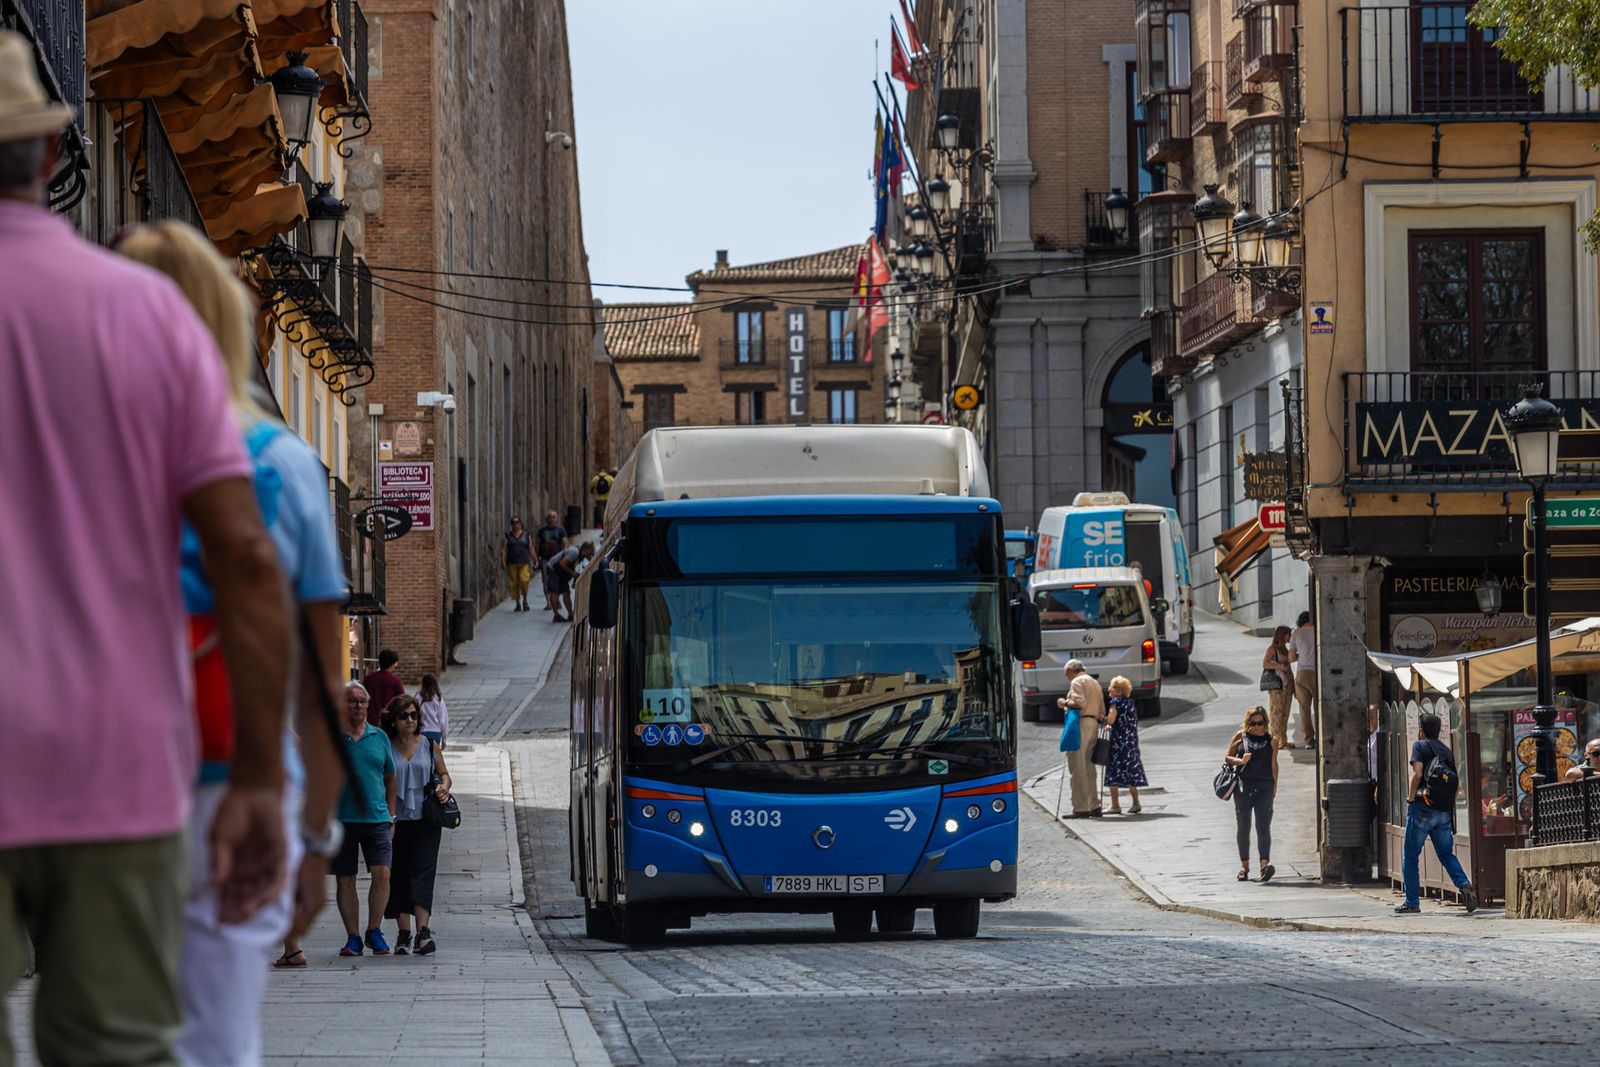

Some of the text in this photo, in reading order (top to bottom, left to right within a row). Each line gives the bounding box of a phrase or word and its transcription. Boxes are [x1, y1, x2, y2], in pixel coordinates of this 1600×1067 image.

[789, 313, 804, 416] HOTEL
[383, 467, 423, 476] BIBLIOTECA
[366, 505, 400, 514] RESTAURANTE
[408, 503, 431, 515] EJÉRCITO
[1571, 508, 1586, 518] de
[1396, 629, 1435, 642] Telesforo
[646, 697, 685, 716] L10
[730, 809, 782, 827] 8303
[776, 877, 811, 891] 7889
[816, 877, 843, 891] HKL
